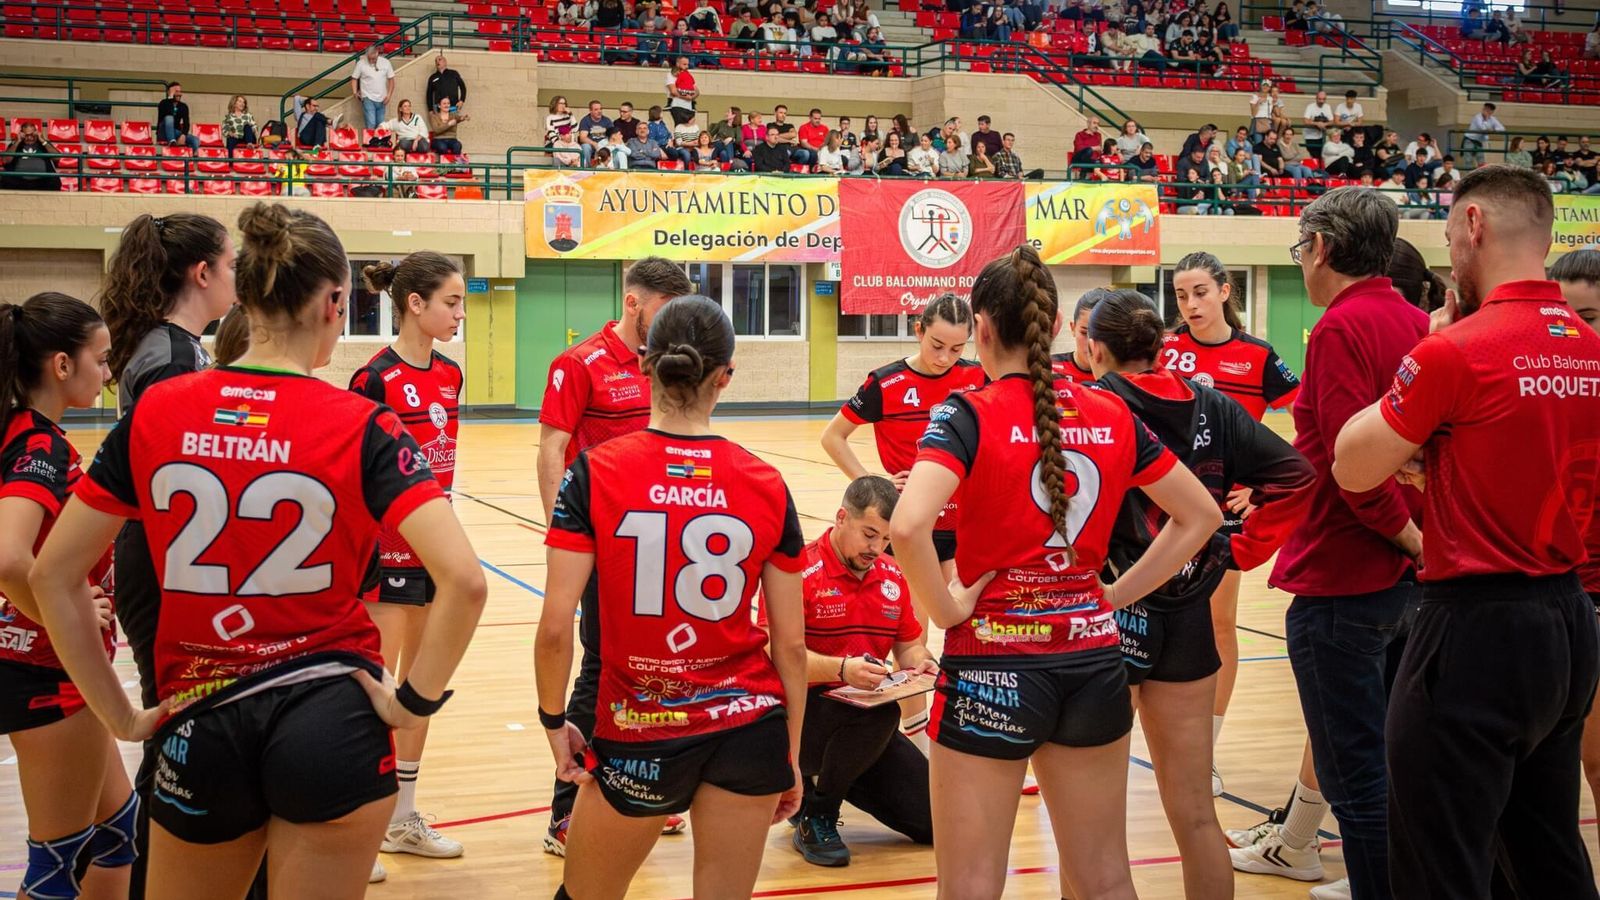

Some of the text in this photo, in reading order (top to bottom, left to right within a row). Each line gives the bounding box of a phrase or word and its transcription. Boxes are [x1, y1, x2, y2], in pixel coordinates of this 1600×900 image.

[599, 188, 841, 217] AYUNTAMIENTO D
[654, 229, 768, 250] Delegación
[775, 231, 799, 248] de
[853, 275, 883, 287] CLUB
[886, 275, 956, 288] BALONMANO
[1164, 348, 1197, 373] 28
[1512, 354, 1550, 371] Club
[403, 383, 420, 408] 8
[903, 387, 921, 408] 4
[1518, 376, 1600, 399] ROQUET
[1010, 426, 1029, 443] A.
[181, 432, 291, 464] BELTRÁN
[649, 483, 728, 508] GARCÍA
[1030, 448, 1102, 549] 9
[151, 462, 337, 597] 22
[614, 510, 755, 622] 18
[978, 685, 1020, 708] MAR
[624, 760, 660, 781] MAR
